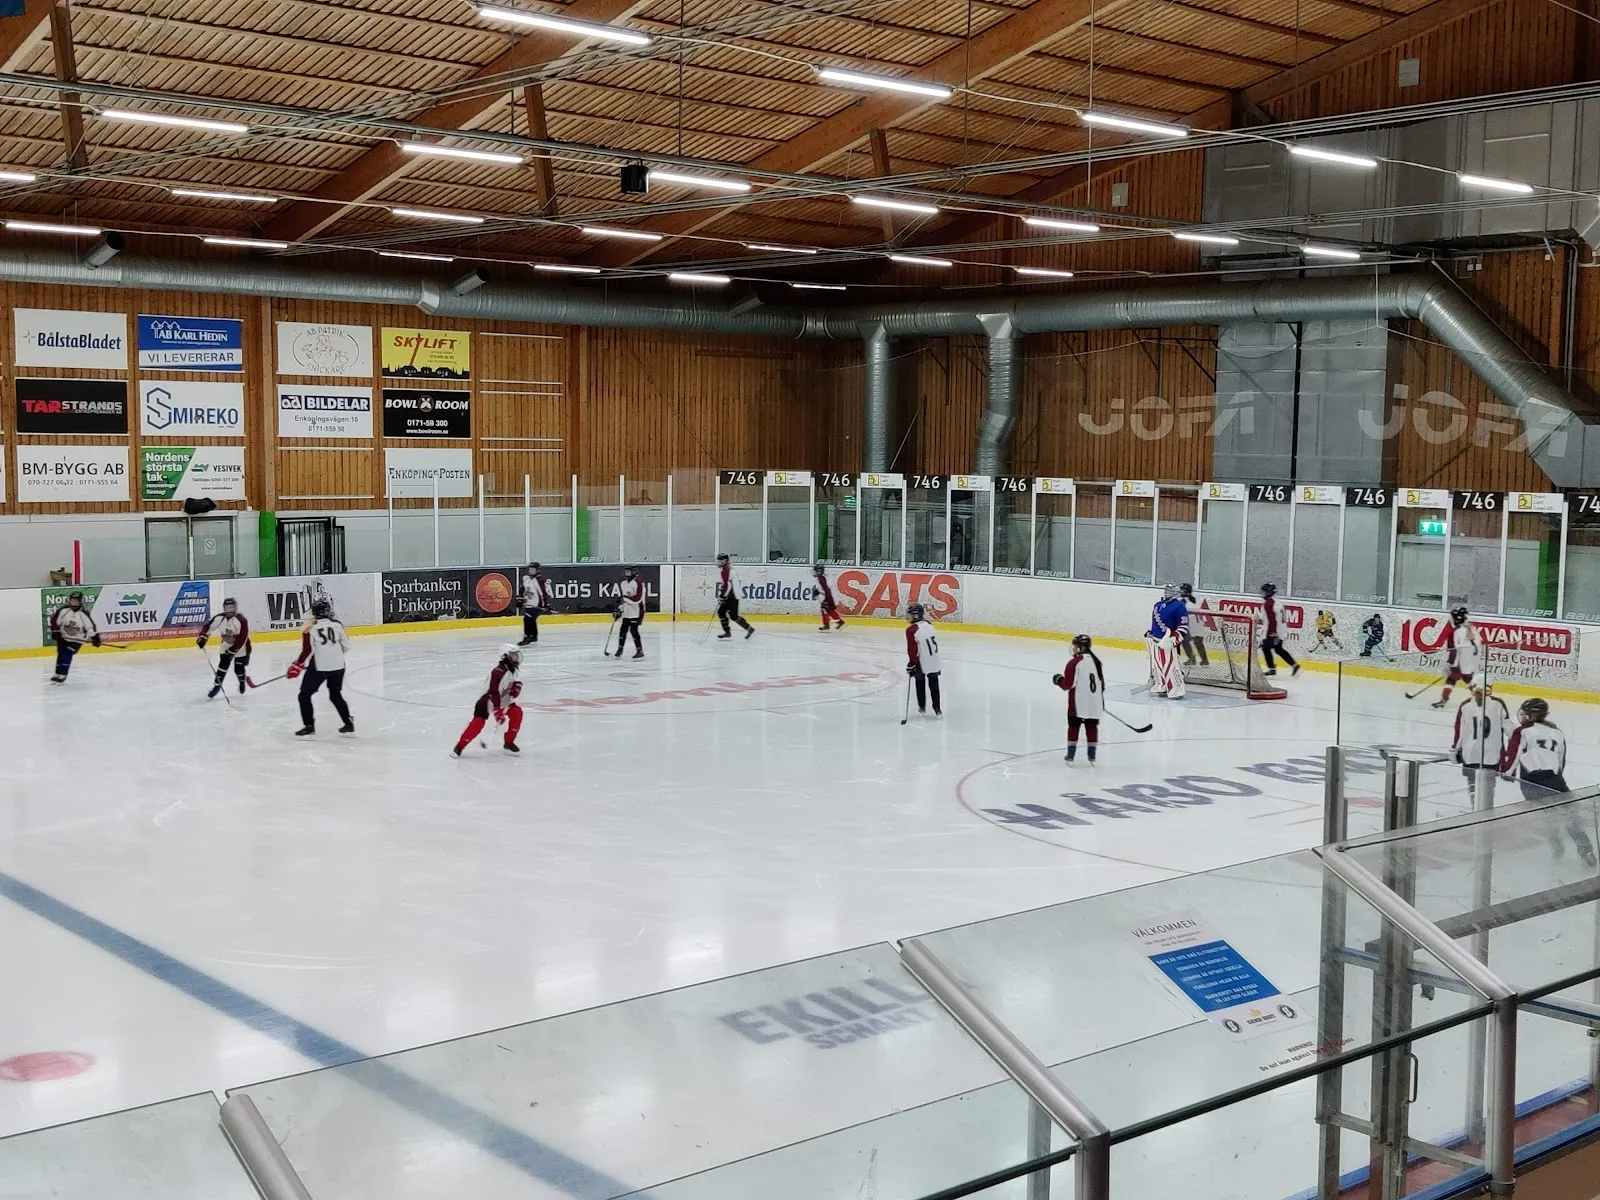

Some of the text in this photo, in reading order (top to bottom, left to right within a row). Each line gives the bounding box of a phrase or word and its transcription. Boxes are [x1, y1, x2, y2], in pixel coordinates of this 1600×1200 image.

[38, 331, 121, 350] BålstaBladet
[159, 330, 228, 341] AB KARL HEDIN
[393, 335, 457, 349] SKYLIFT
[148, 352, 234, 363] VI LEVERERAR
[306, 363, 345, 374] SNICKARE
[306, 397, 369, 410] BILDELAR
[385, 399, 469, 410] BOWL ROOM
[295, 415, 349, 424] Enköpingsvägen
[407, 419, 434, 427] 0171-59
[1079, 392, 1254, 440] JOFA
[145, 452, 190, 462] Nordens
[22, 463, 124, 475] BM-BYGG AB
[146, 462, 183, 472] största
[146, 472, 167, 482] tak-
[727, 471, 757, 485] 746
[822, 473, 851, 487] 746
[913, 475, 941, 489] 746
[1000, 477, 1027, 492] 746
[1256, 485, 1285, 501] 746
[1354, 488, 1386, 505] 746
[1461, 492, 1496, 510] 746
[1578, 496, 1600, 513] 74
[383, 577, 461, 597] Sparbanken
[544, 579, 591, 598] ÅDÖS
[836, 570, 960, 620] SATS
[390, 597, 461, 616] i Enköping
[1223, 604, 1299, 623] KVANM
[105, 610, 158, 625] VESIVEK
[171, 614, 206, 625] garanti
[318, 627, 336, 645] 50
[925, 636, 938, 656] 15
[1419, 655, 1440, 668] Din
[1512, 653, 1567, 668] Centrum
[1089, 673, 1097, 693] 8
[981, 775, 1263, 830] HÅBO
[1132, 919, 1197, 938] VÄLKOMMEN
